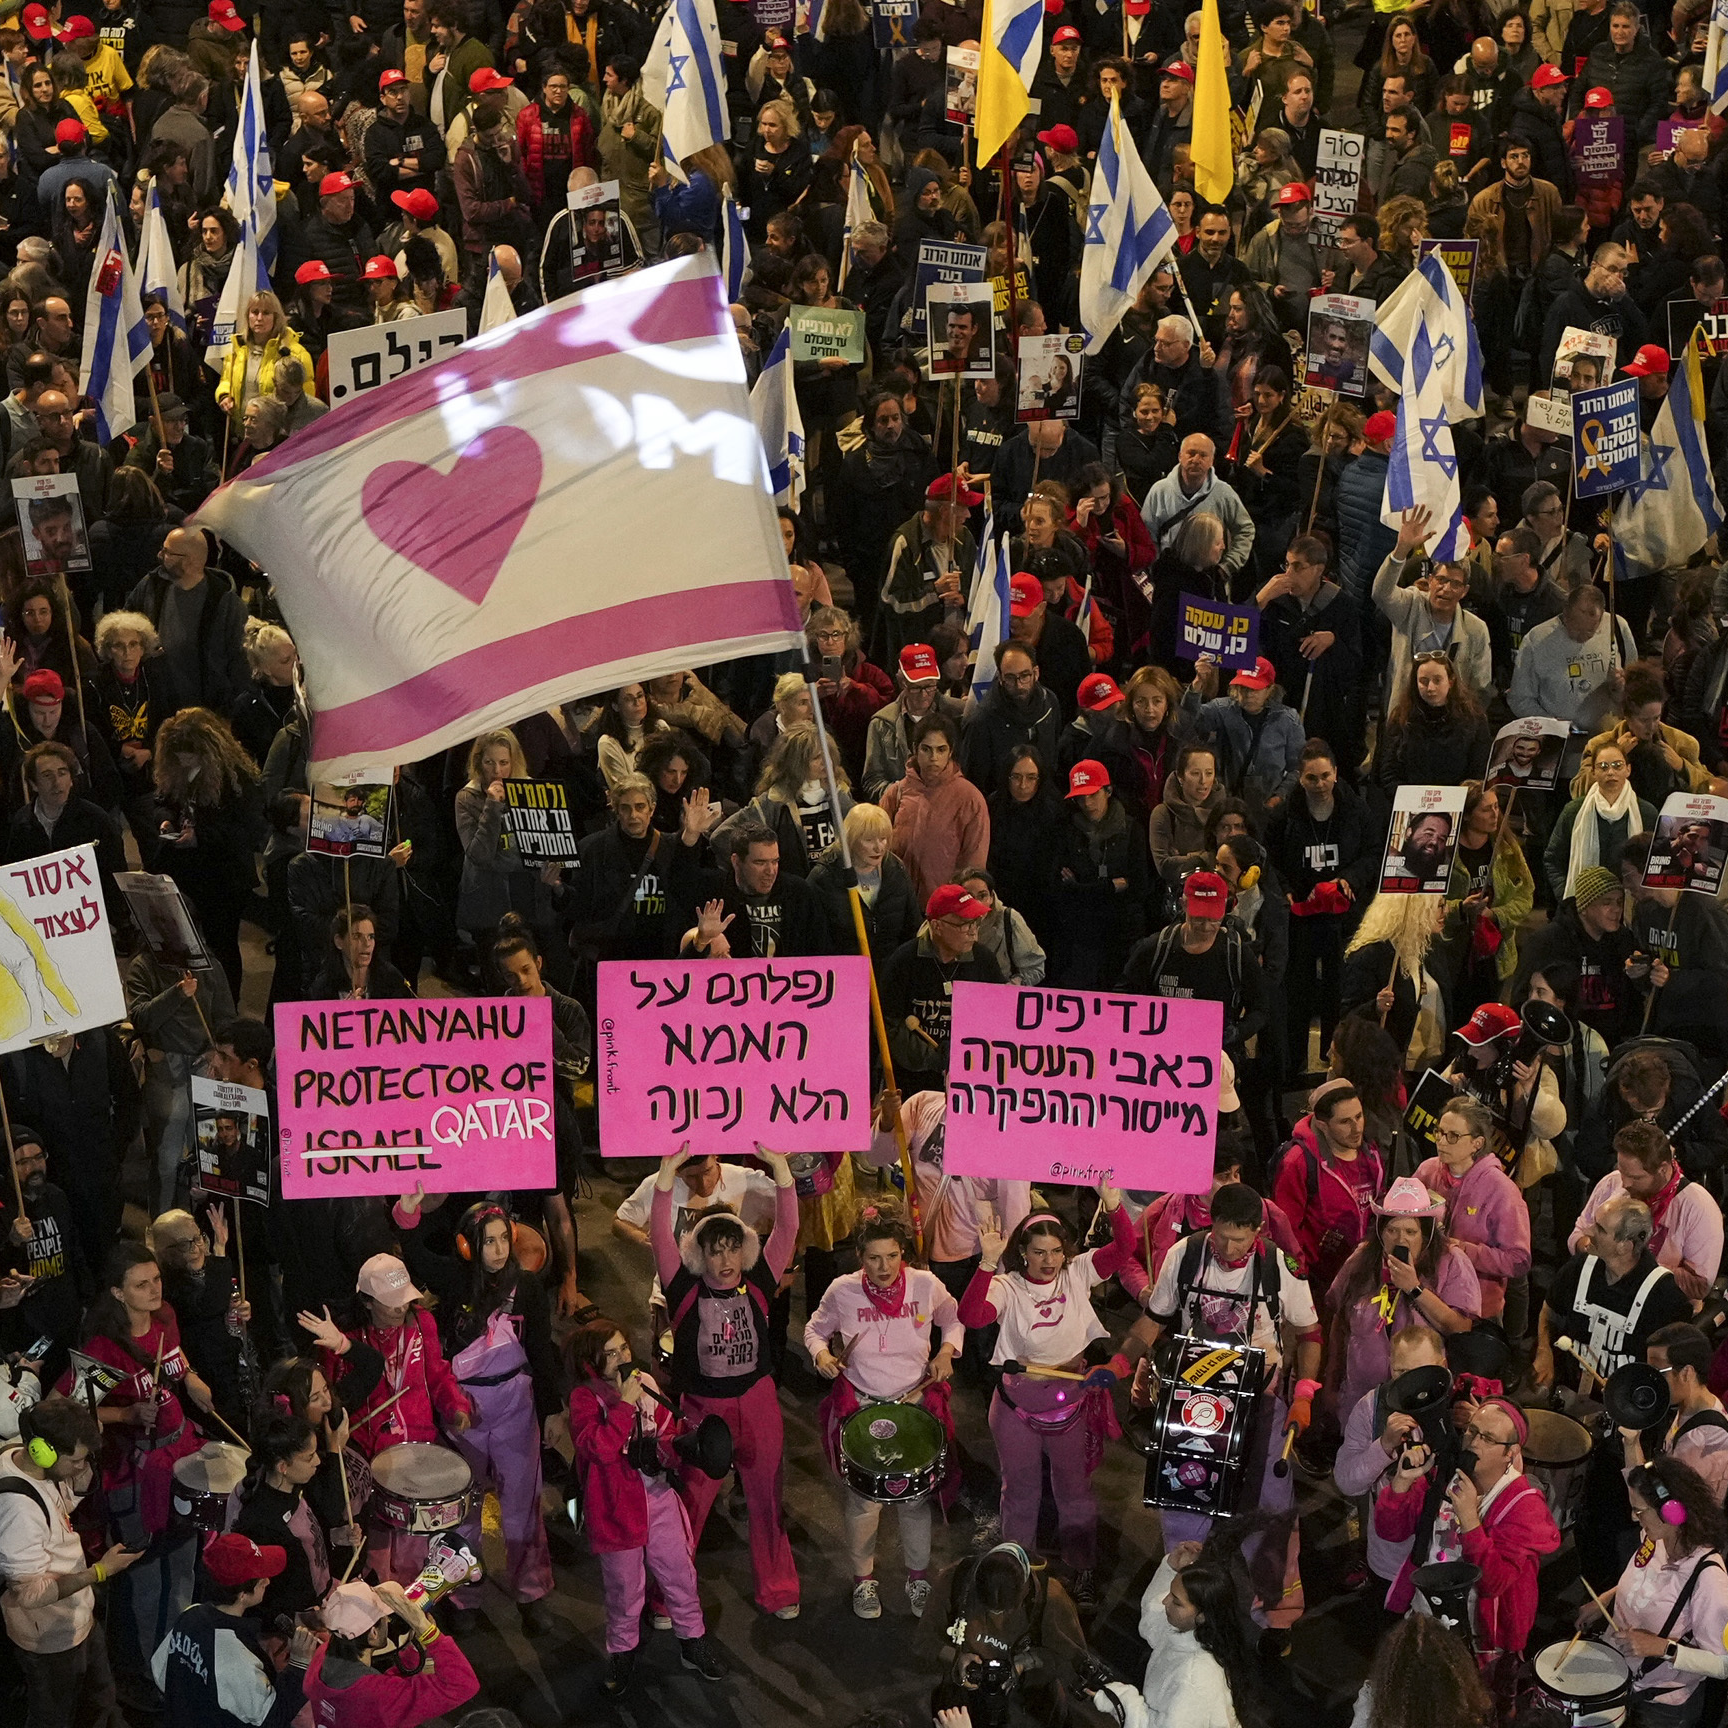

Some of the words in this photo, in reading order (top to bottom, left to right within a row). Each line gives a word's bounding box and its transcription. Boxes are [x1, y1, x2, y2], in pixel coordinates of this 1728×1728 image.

[796, 319, 831, 334] מרפים
[804, 332, 832, 347] שכולם
[834, 337, 847, 347] עד
[835, 322, 854, 337] לא
[1183, 624, 1222, 651] שלום
[1185, 605, 1227, 631] עסקה
[1227, 616, 1250, 635] כן,
[1224, 634, 1248, 656] כן,
[506, 782, 566, 809] נלחמים
[9, 856, 96, 899] אסור
[33, 894, 102, 940] לעצור
[630, 970, 692, 1009] על
[704, 964, 837, 1008] נפלתם
[1159, 975, 1178, 987] BRING
[299, 1006, 527, 1052] NETANYAHU
[1015, 990, 1170, 1036] עדיפים
[660, 1020, 809, 1066] האמא
[960, 1037, 1096, 1085] העסקה
[293, 1065, 493, 1109] PROTECTOR
[500, 1060, 548, 1094] OF
[1109, 1050, 1213, 1088] כאבי
[648, 1082, 744, 1134] נכונה
[769, 1077, 850, 1125] הלא
[429, 1098, 553, 1149] QATAR
